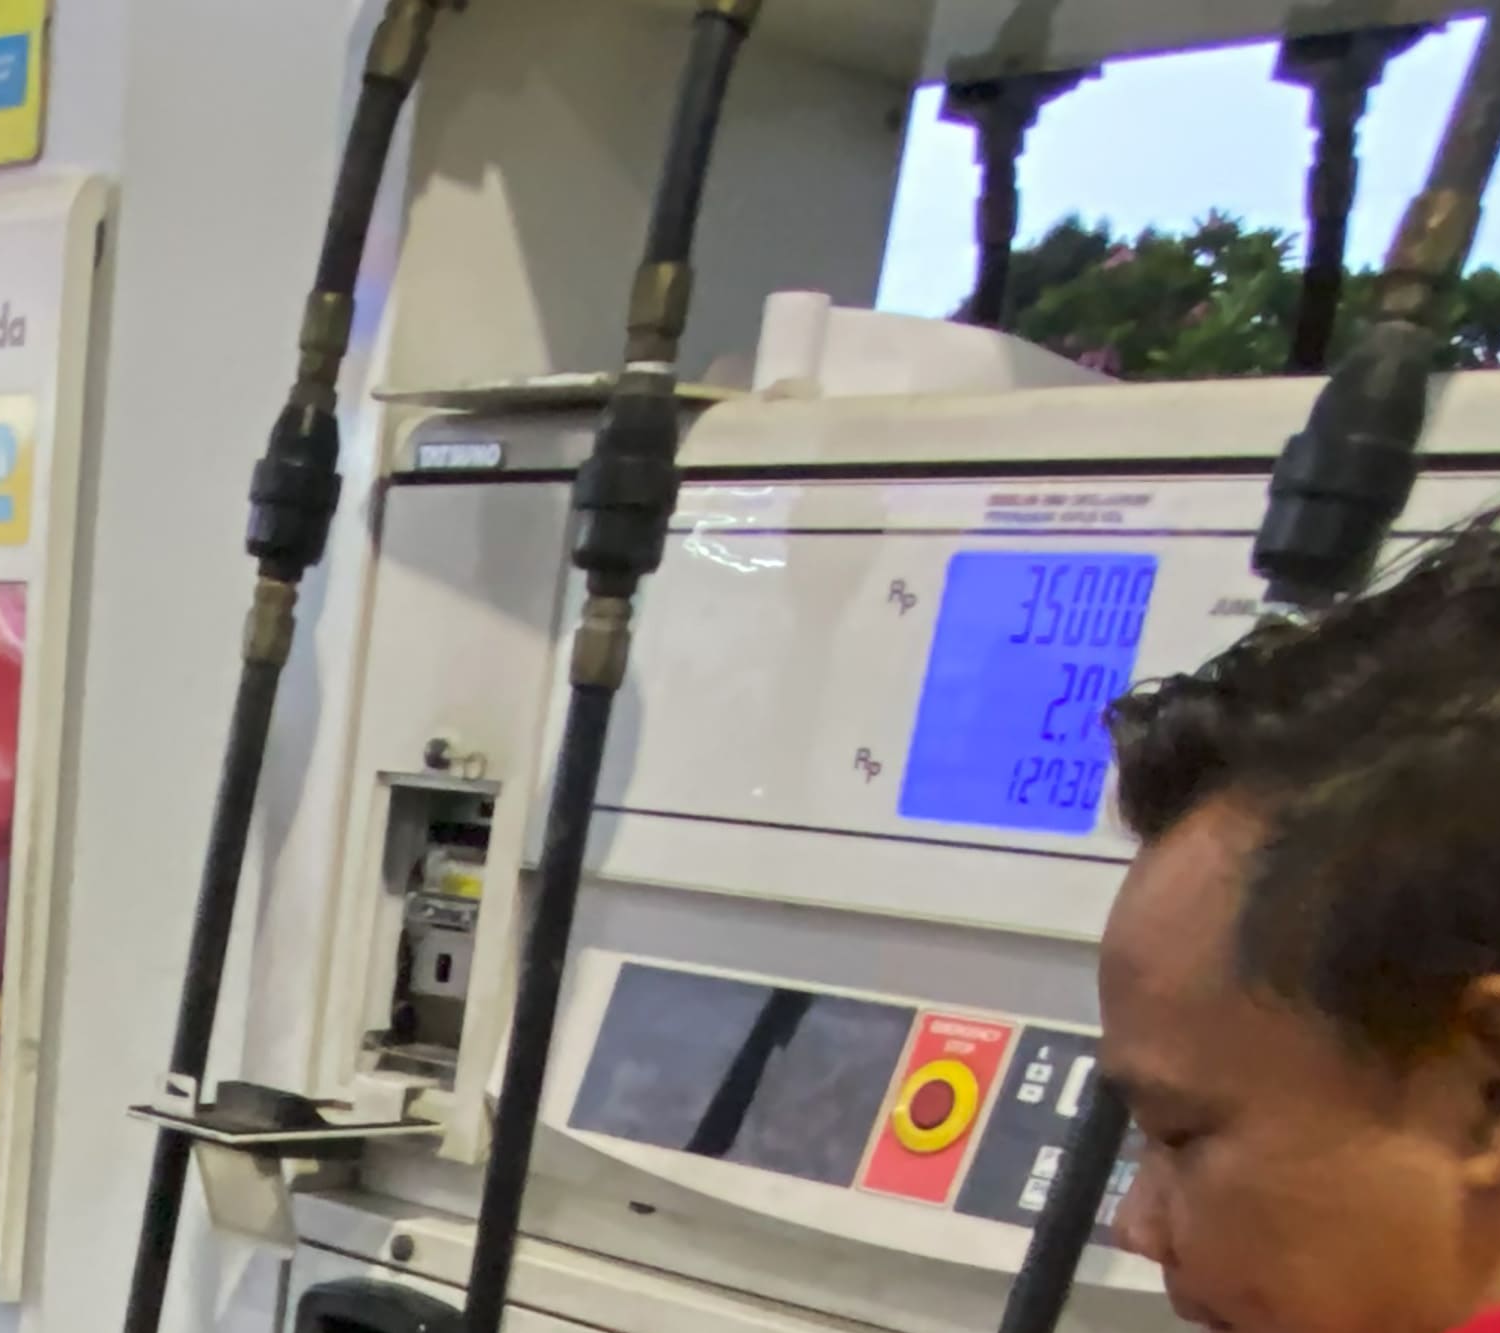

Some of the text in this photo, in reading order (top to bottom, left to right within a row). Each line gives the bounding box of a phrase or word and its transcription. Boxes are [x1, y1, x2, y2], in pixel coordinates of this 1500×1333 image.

[887, 578, 918, 616] Rp
[1008, 565, 1156, 648] 35000
[853, 746, 883, 784] Rp
